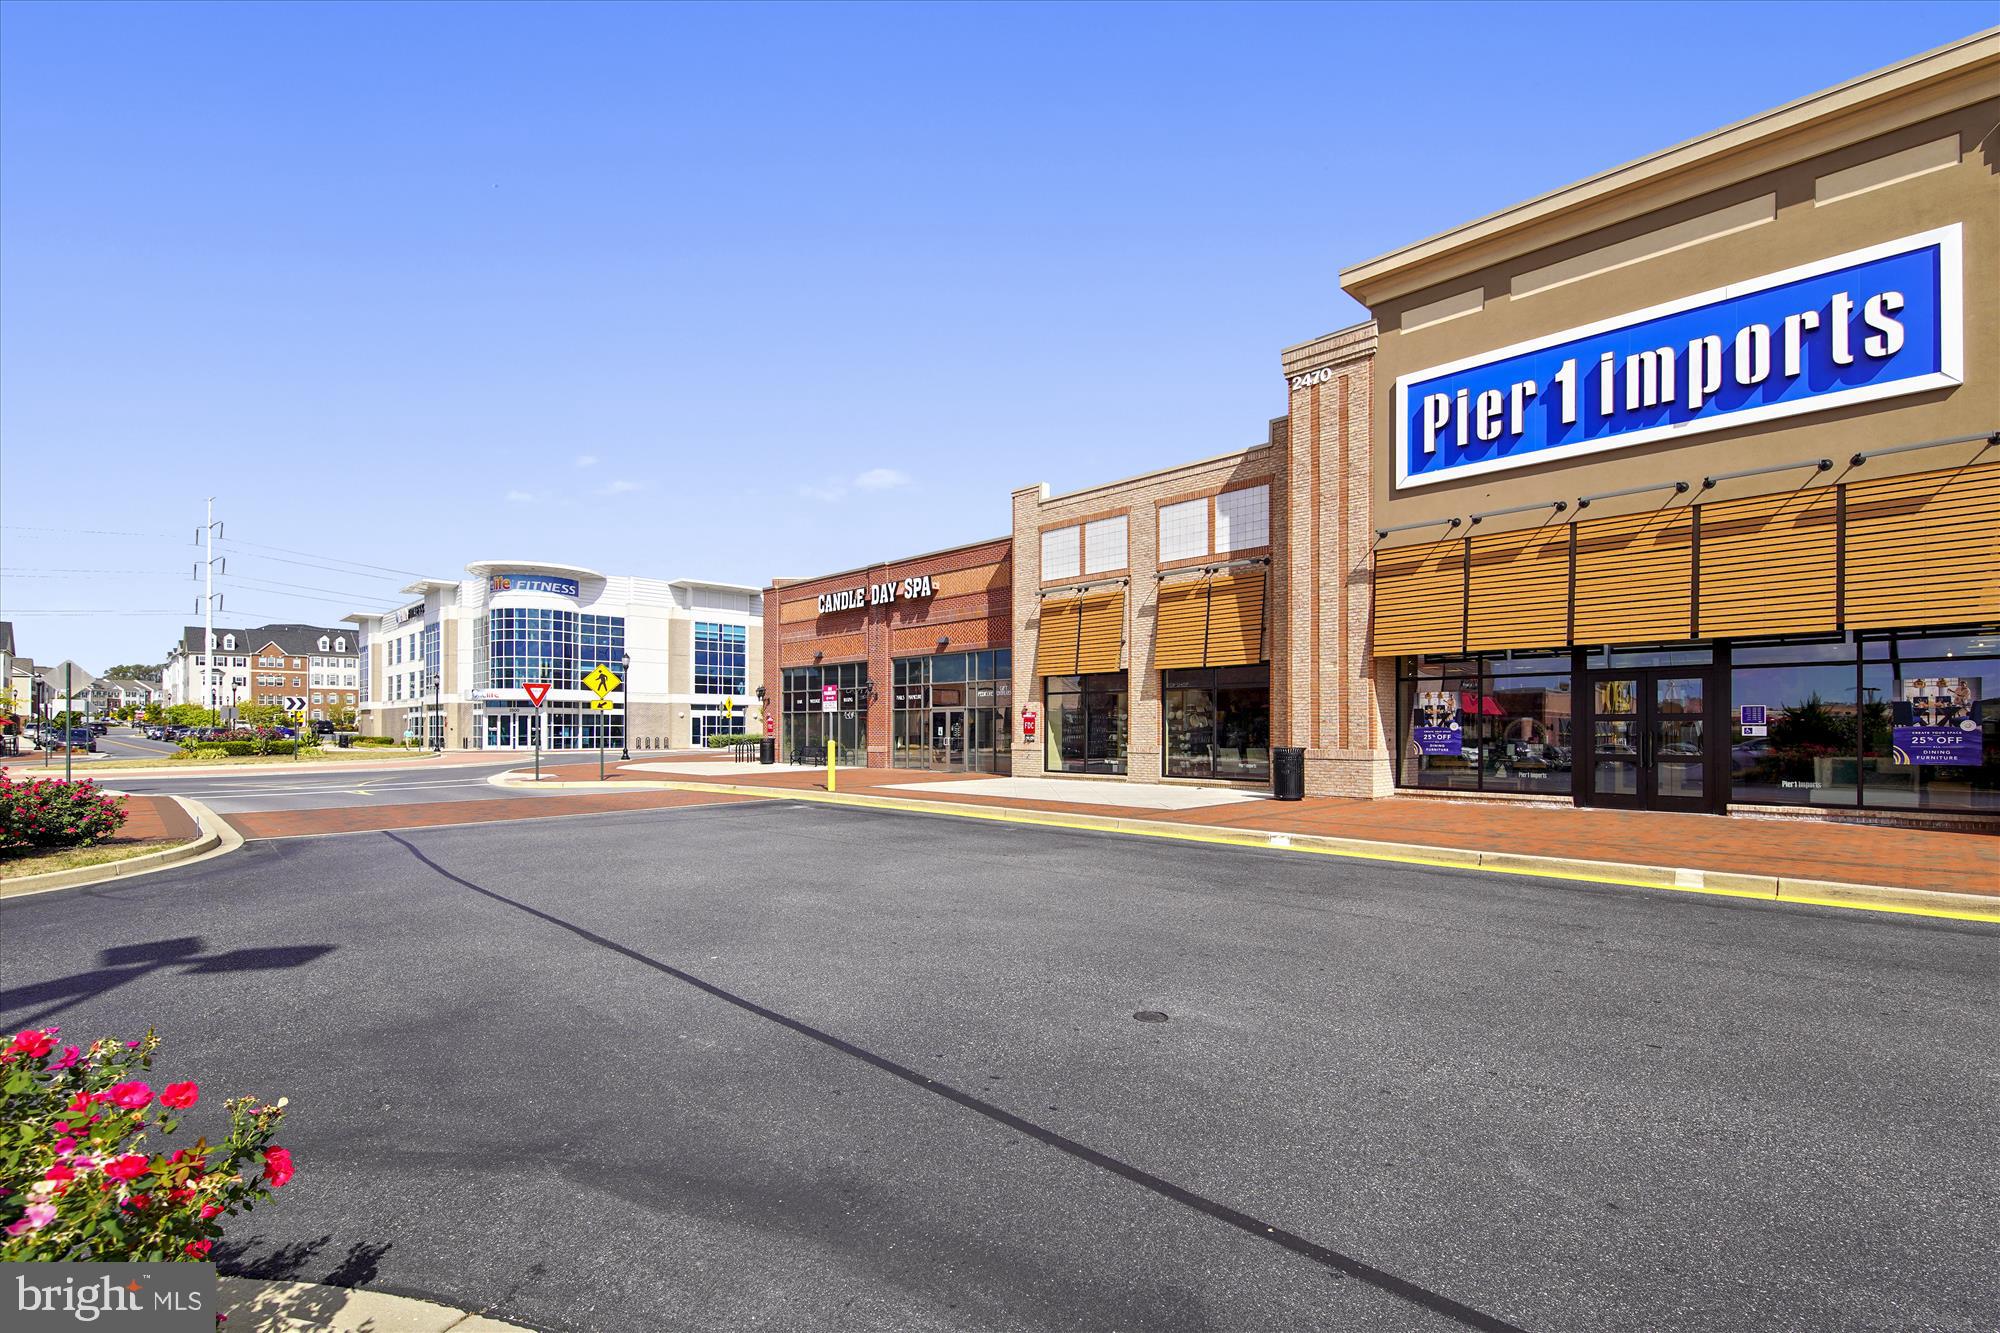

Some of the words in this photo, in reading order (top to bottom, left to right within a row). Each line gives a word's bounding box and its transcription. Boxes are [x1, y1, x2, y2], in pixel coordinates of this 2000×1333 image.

[1292, 367, 1332, 391] 2470
[1423, 378, 1538, 455] Pier
[1554, 357, 1578, 426] 1
[1600, 289, 1906, 417] imports
[516, 580, 577, 595] FITNESS
[818, 587, 865, 613] CANDLE
[871, 582, 897, 605] DAY
[904, 575, 932, 599] SPA
[1024, 722, 1035, 730] FDC
[1911, 736, 1934, 744] 25%
[1936, 736, 1963, 744] OFF
